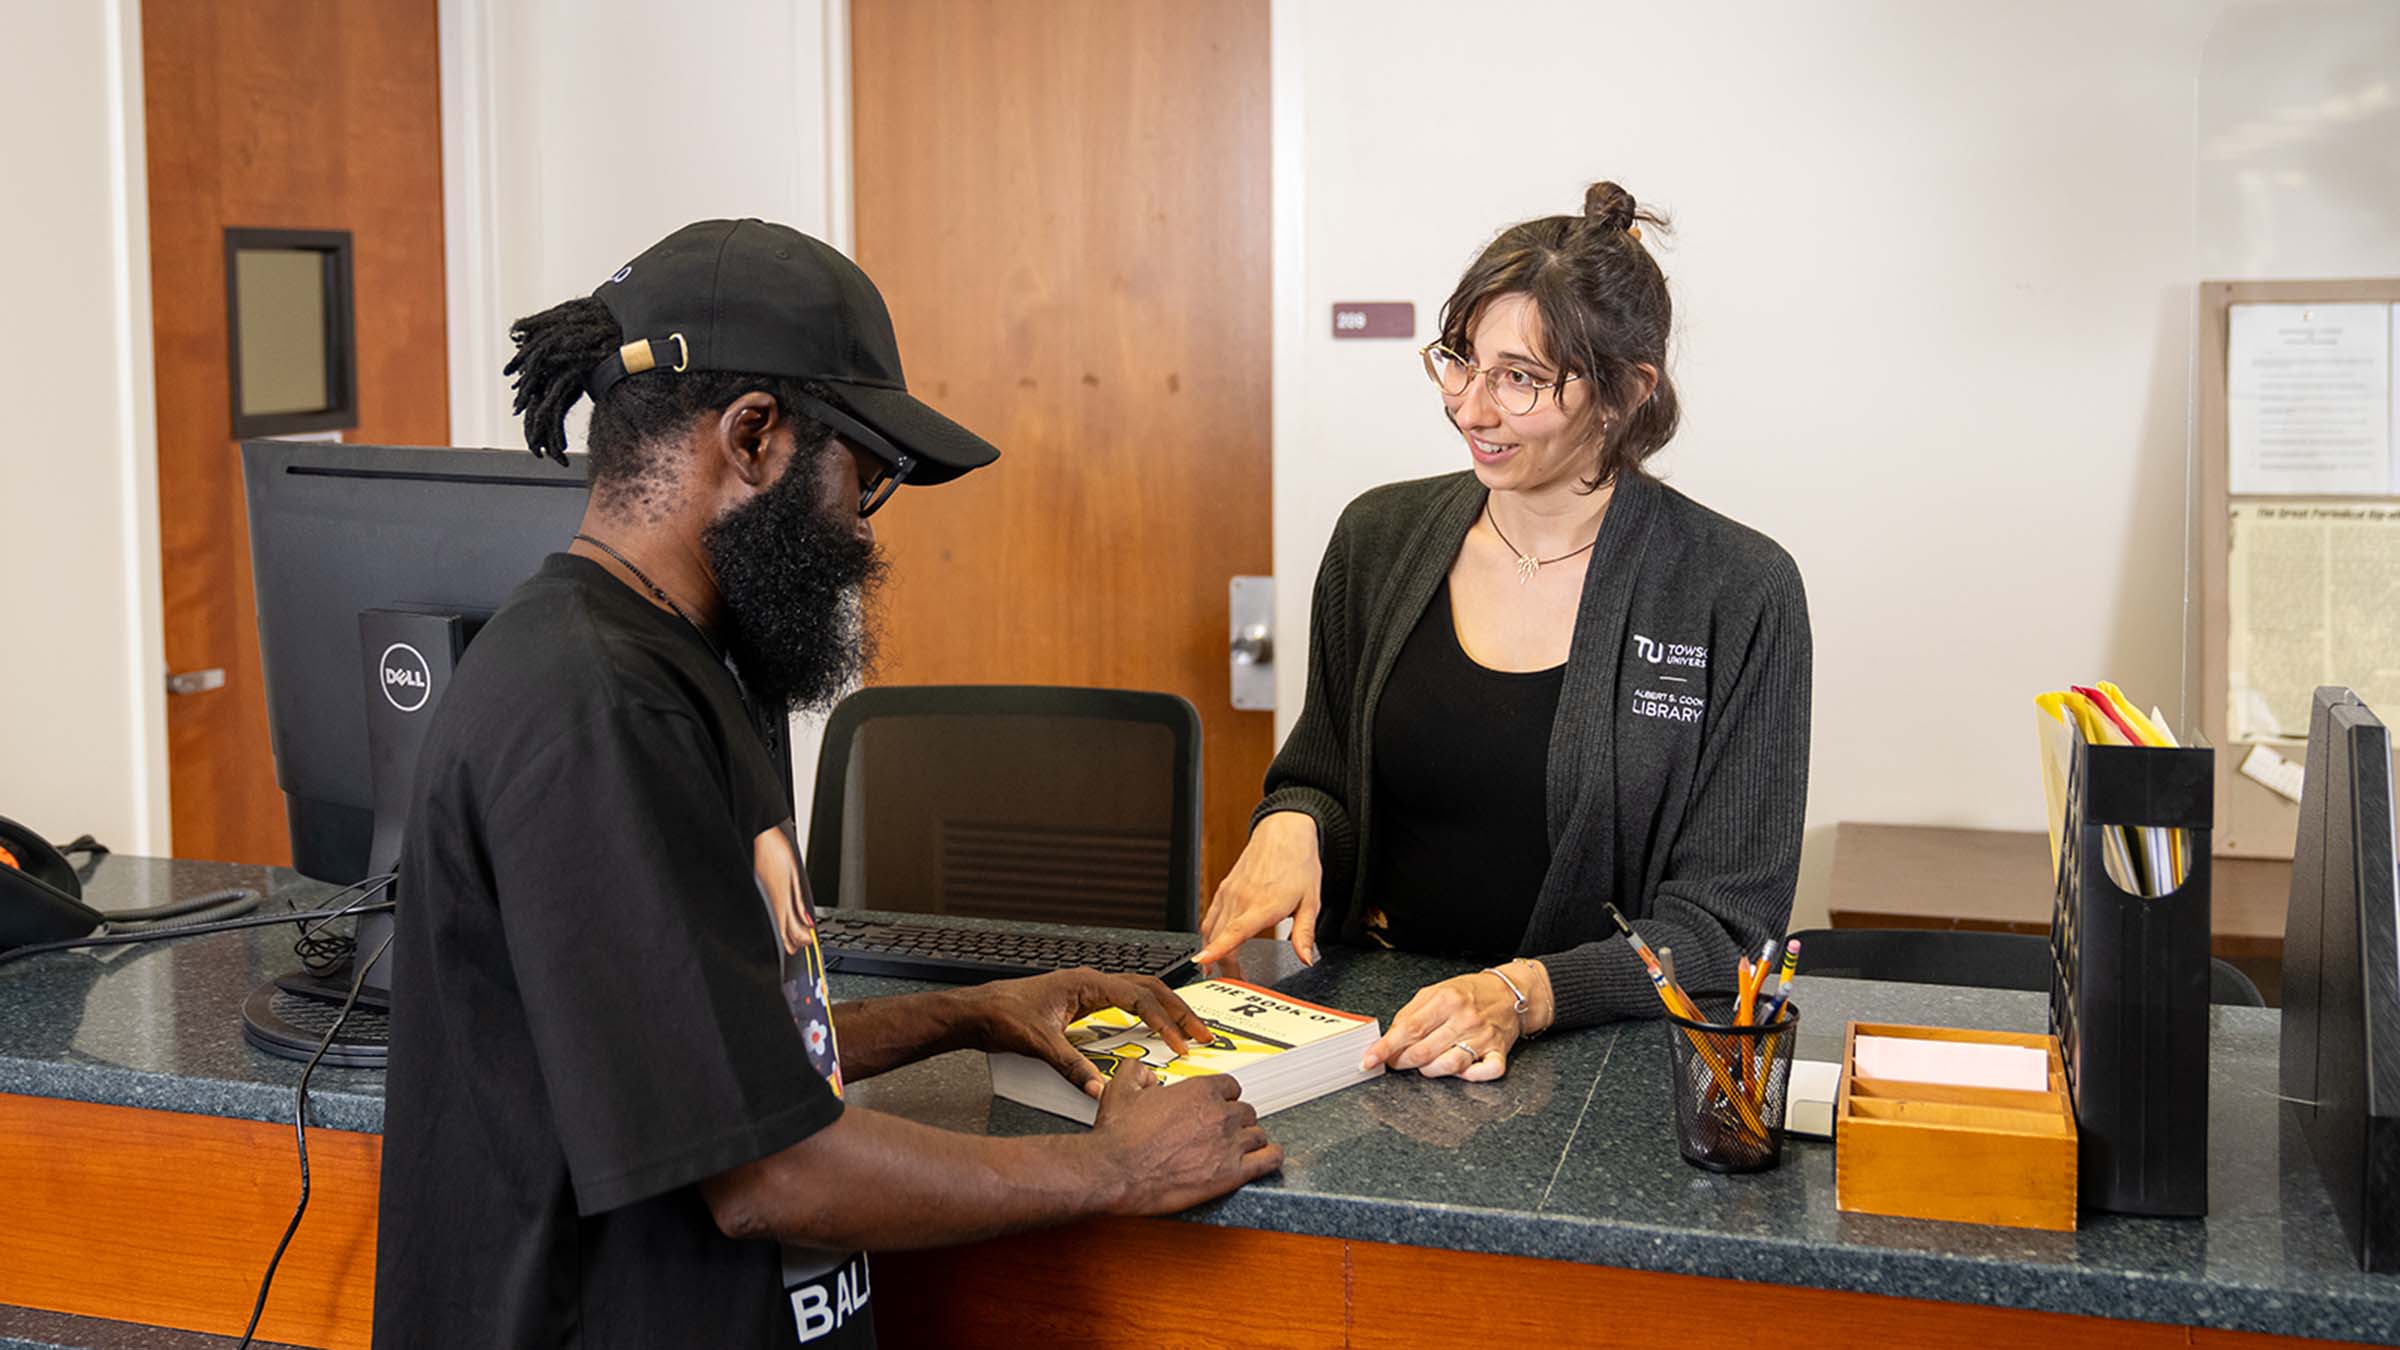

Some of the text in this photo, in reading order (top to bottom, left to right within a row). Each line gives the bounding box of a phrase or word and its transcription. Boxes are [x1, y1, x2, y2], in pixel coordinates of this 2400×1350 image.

[385, 667, 426, 688] DELL
[1634, 688, 1667, 701] ALBERT
[1632, 699, 1703, 723] LIBRARY
[1205, 982, 1342, 1025] THE BOOK OF
[1229, 1003, 1268, 1018] R
